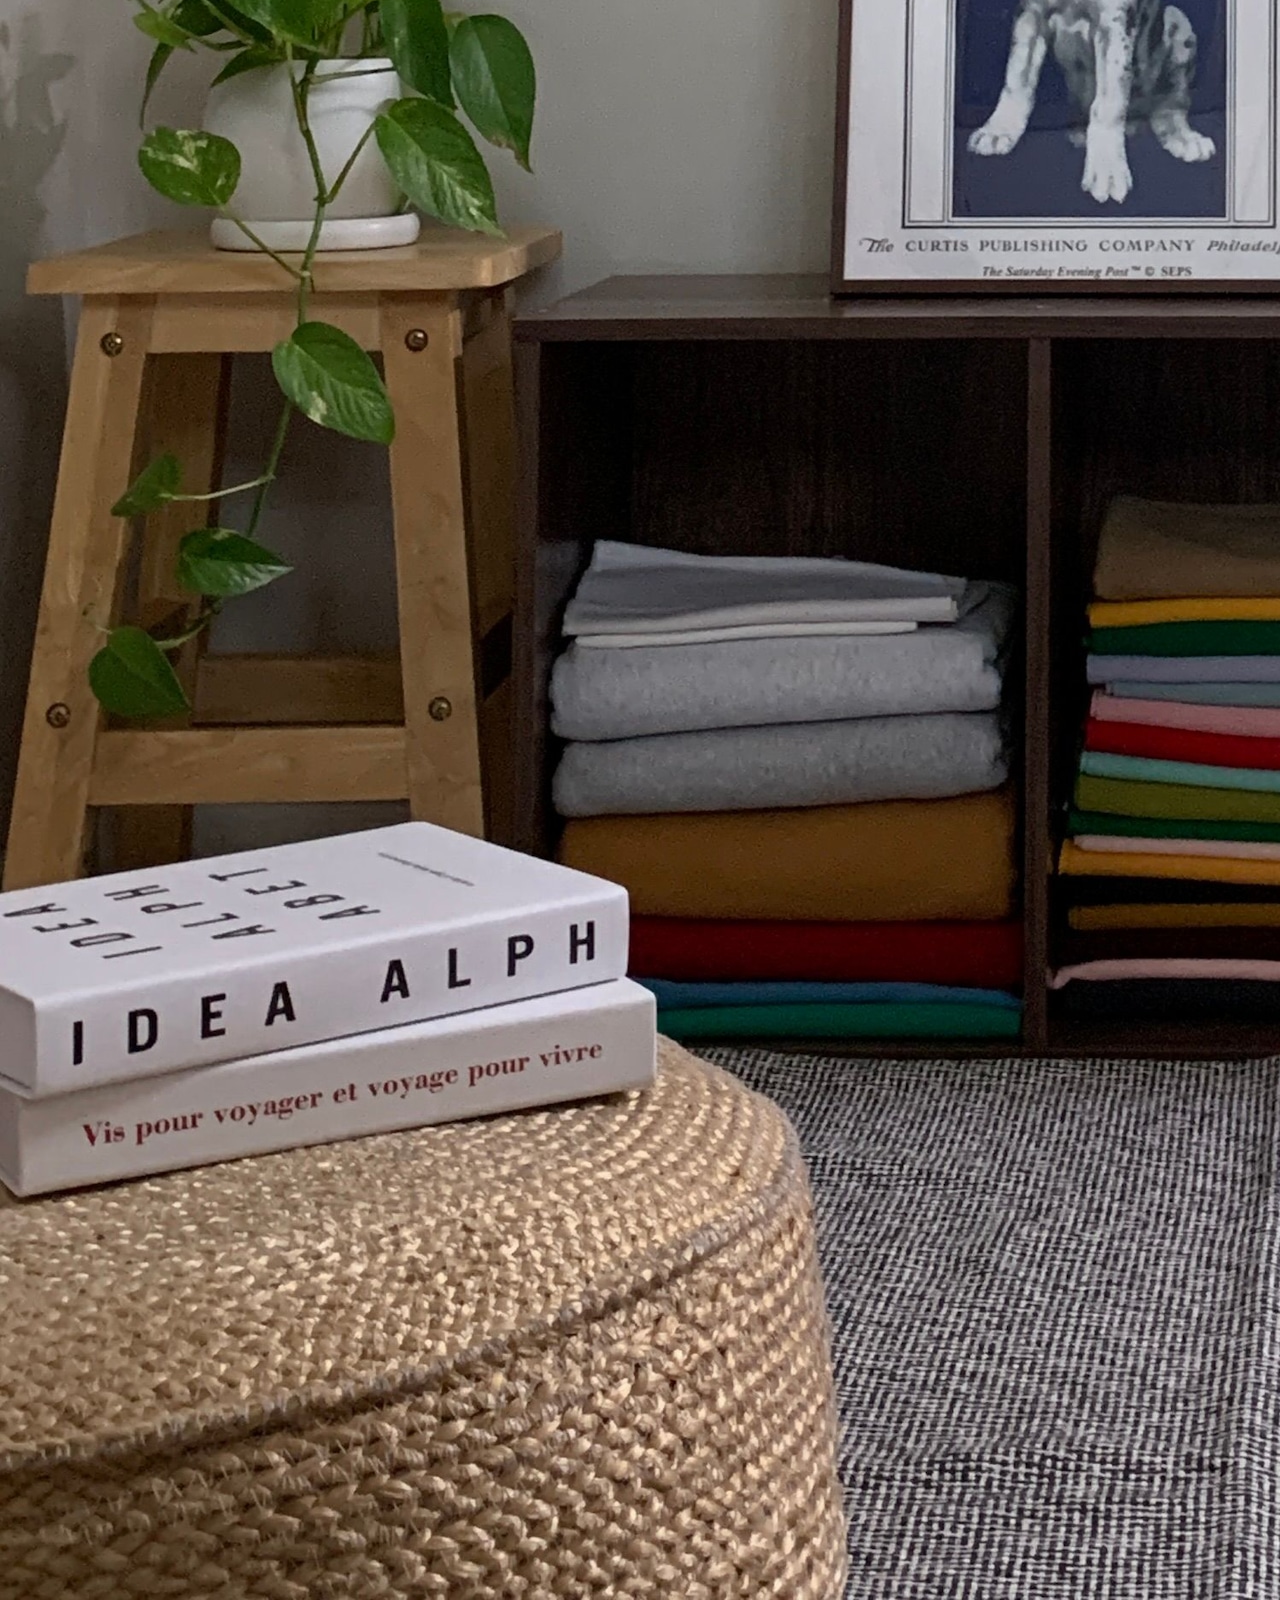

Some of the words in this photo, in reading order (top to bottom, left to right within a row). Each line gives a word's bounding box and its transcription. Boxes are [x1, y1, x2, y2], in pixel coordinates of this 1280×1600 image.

[859, 237, 894, 253] The
[905, 239, 969, 252] CURTIS
[978, 239, 1088, 252] PUBLISHING
[1099, 239, 1196, 252] COMPANY
[982, 266, 1002, 277] The
[1005, 266, 1053, 279] Saturday
[1057, 266, 1102, 279] Evening
[1160, 266, 1193, 277] SEPS
[72, 981, 297, 1066] IDEA
[380, 920, 596, 1004] ALPH
[82, 1120, 126, 1147] Vis
[135, 1111, 203, 1145] pour
[213, 1090, 323, 1125] voyager
[332, 1083, 358, 1103] et
[368, 1068, 459, 1099] voyage
[468, 1055, 530, 1087] pour
[538, 1044, 603, 1068] vivre
